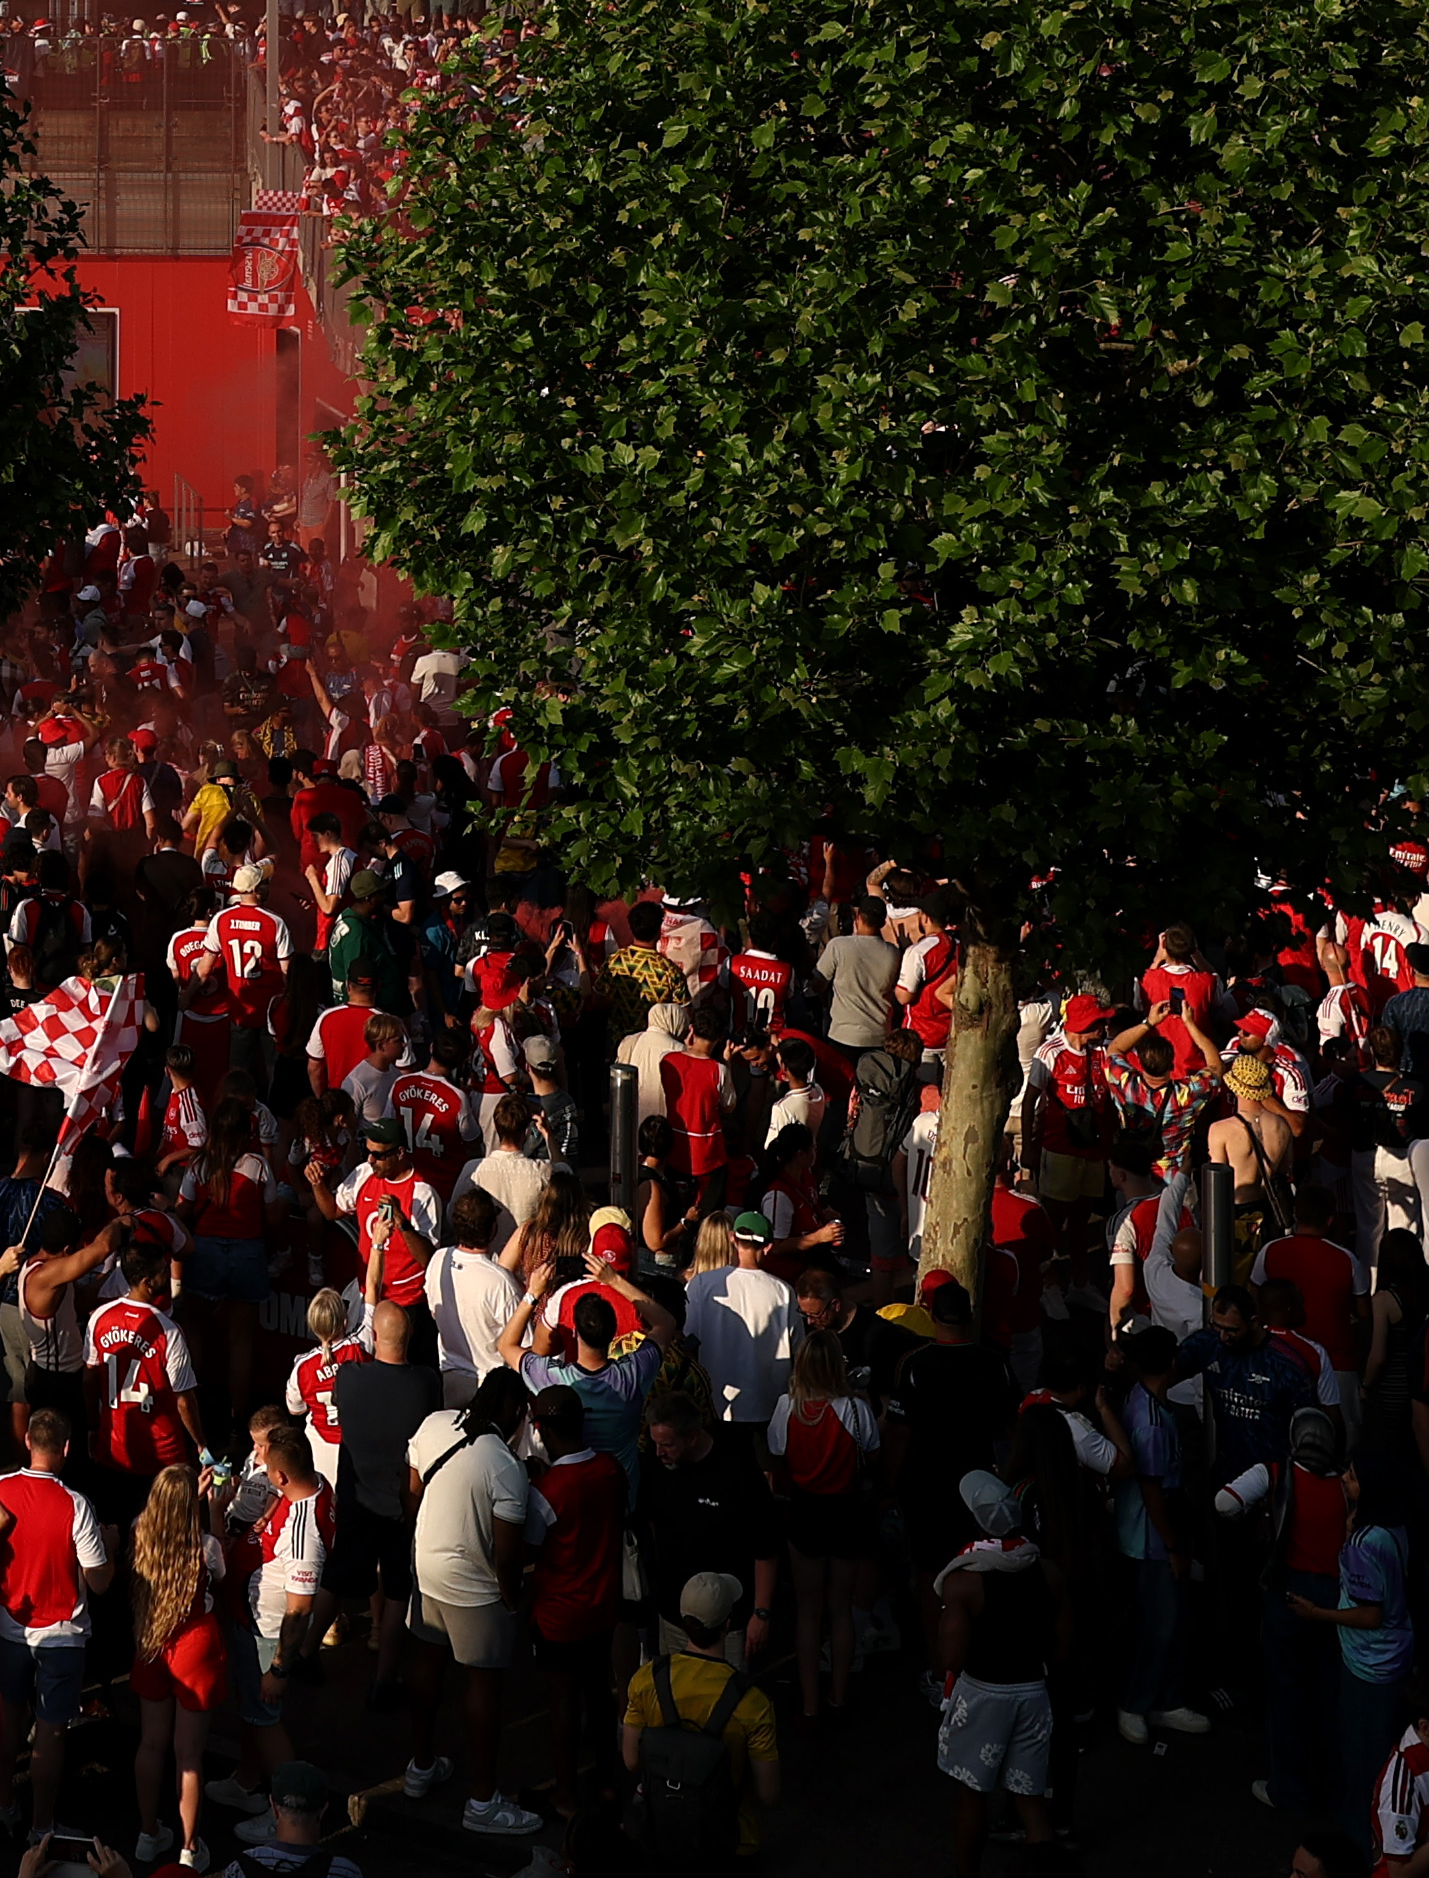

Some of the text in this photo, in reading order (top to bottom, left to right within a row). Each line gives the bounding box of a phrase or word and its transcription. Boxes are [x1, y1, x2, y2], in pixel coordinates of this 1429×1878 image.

[228, 939, 262, 979] 12
[739, 966, 783, 984] SAADAT
[1373, 935, 1399, 979] 14
[398, 1088, 450, 1113] GYÖKERES
[399, 1106, 445, 1158] 14
[99, 1326, 156, 1360] GYÖKERES
[103, 1353, 154, 1413] 14
